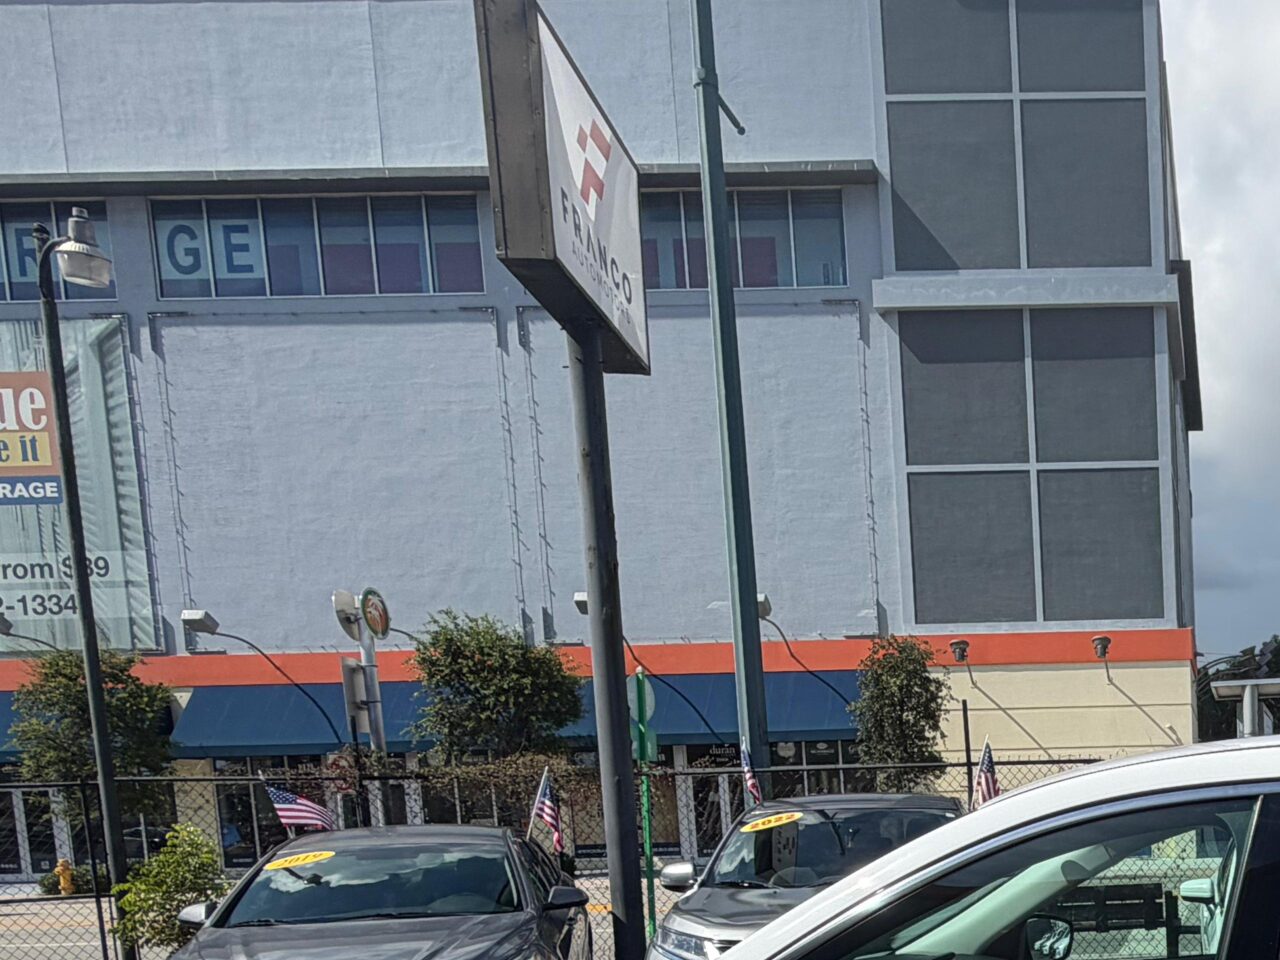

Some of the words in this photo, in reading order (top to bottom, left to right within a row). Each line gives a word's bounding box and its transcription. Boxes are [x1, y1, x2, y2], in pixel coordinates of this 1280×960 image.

[560, 186, 632, 305] FRANCO
[19, 435, 40, 462] it
[0, 482, 59, 498] RAGE
[2, 562, 54, 579] rom
[0, 594, 78, 616] -1334
